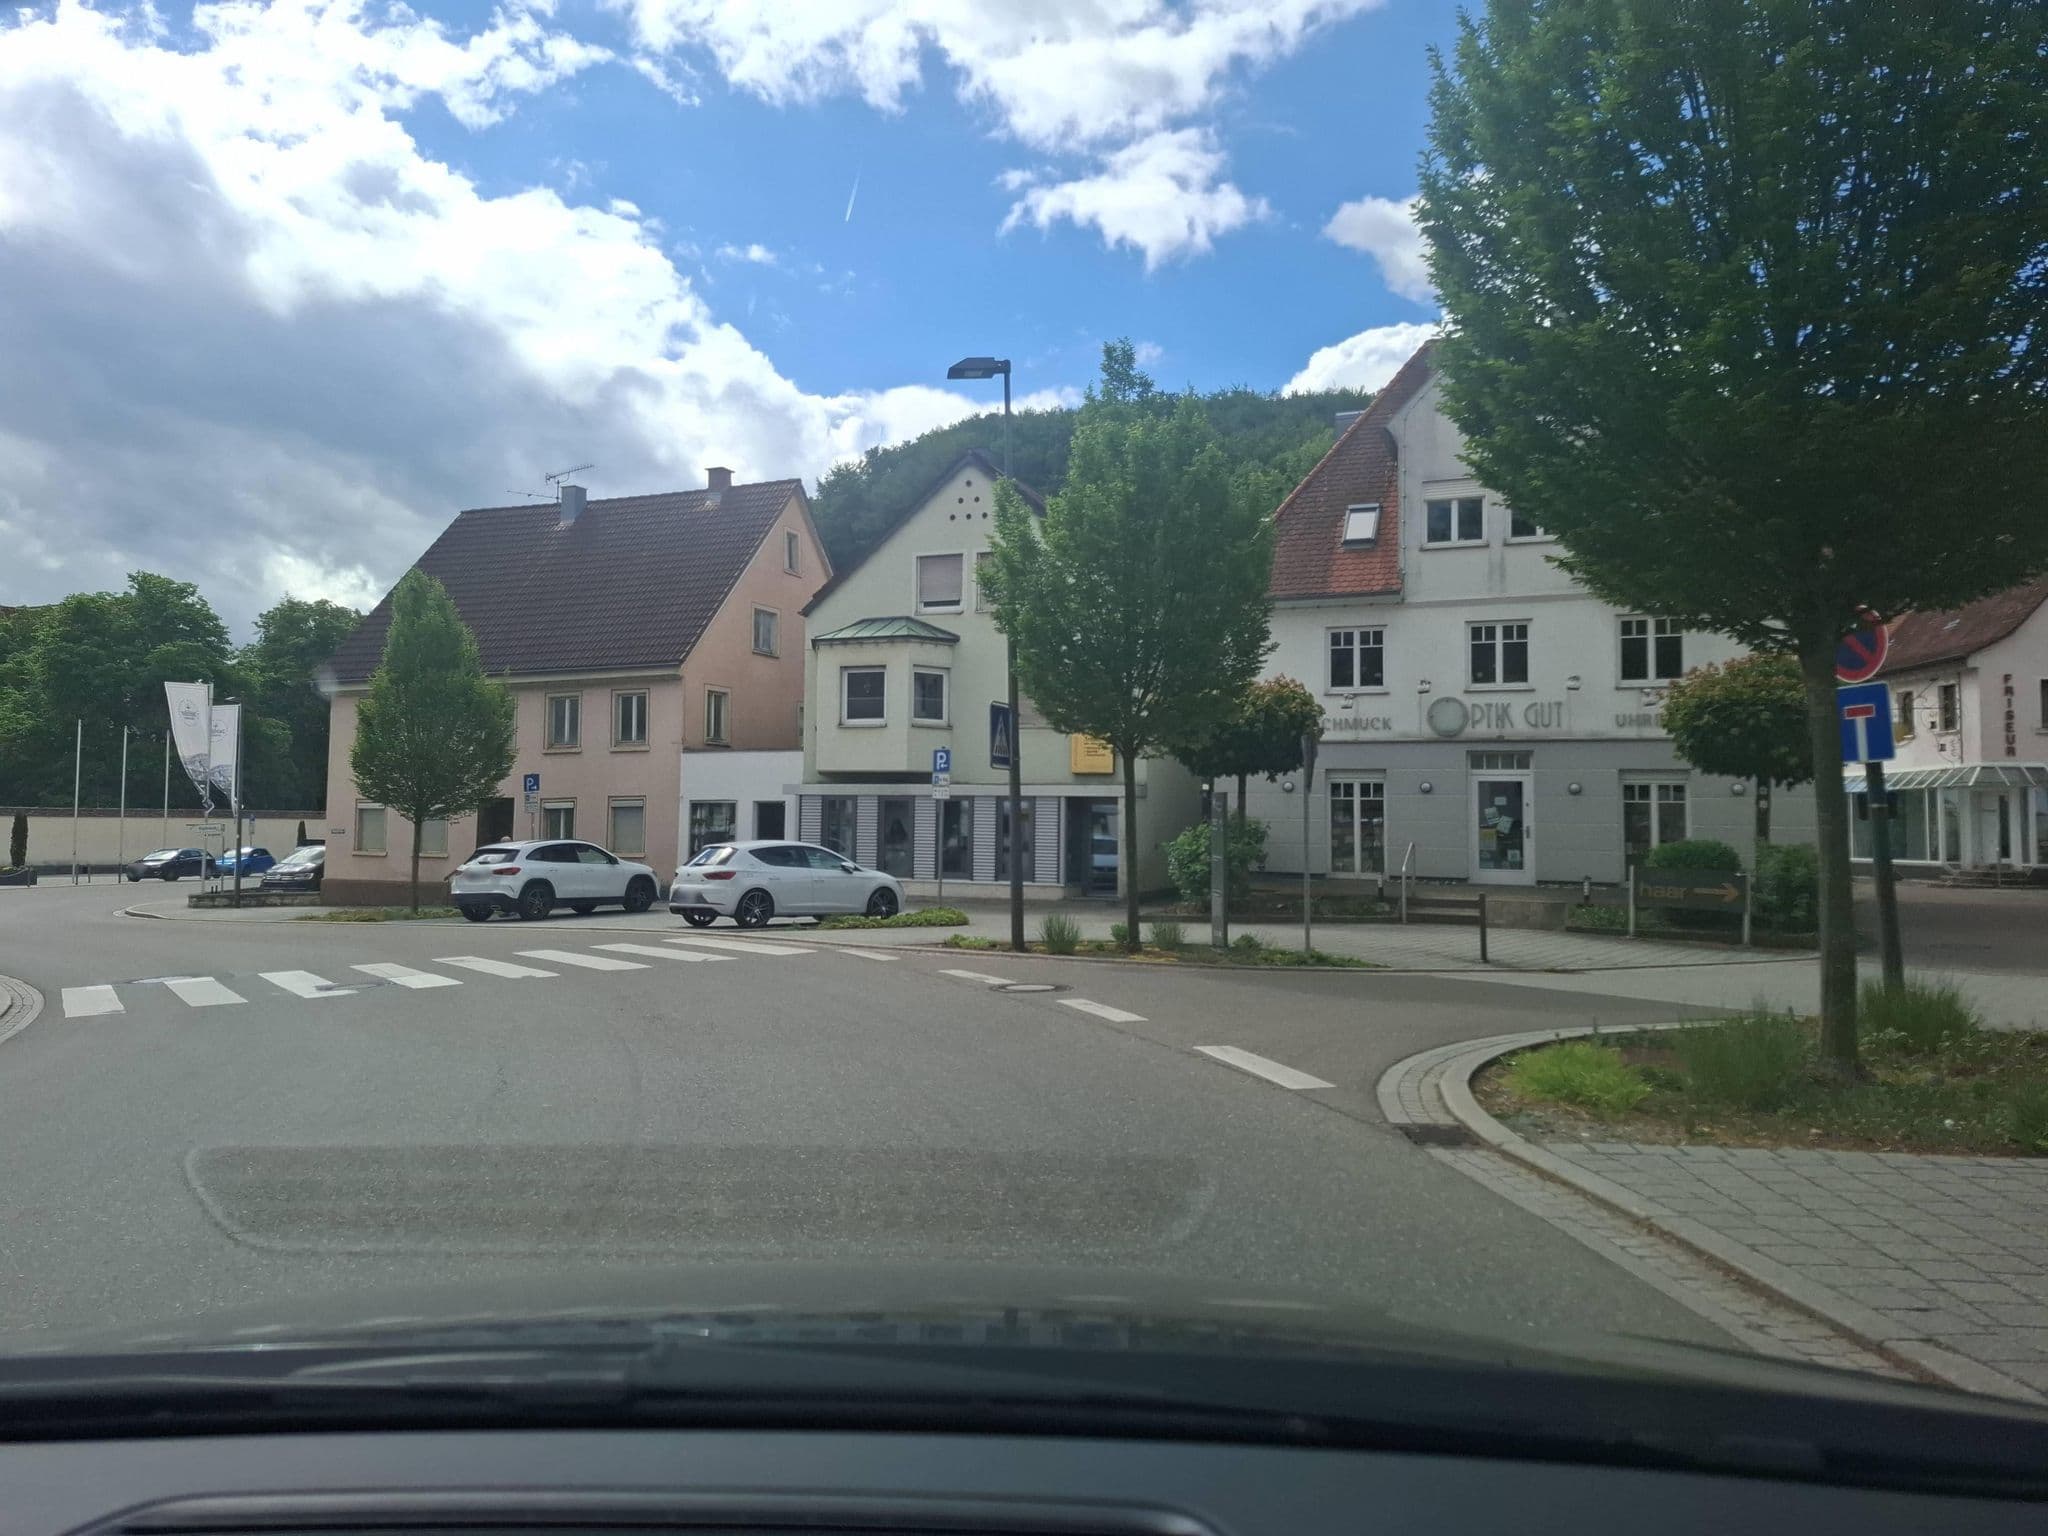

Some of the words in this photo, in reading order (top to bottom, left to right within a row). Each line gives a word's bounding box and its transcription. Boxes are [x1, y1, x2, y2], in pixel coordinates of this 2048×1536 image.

[1321, 717, 1392, 731] CHMUCK
[1524, 702, 1562, 729] GUT
[2003, 673, 2017, 757] FRISEUR
